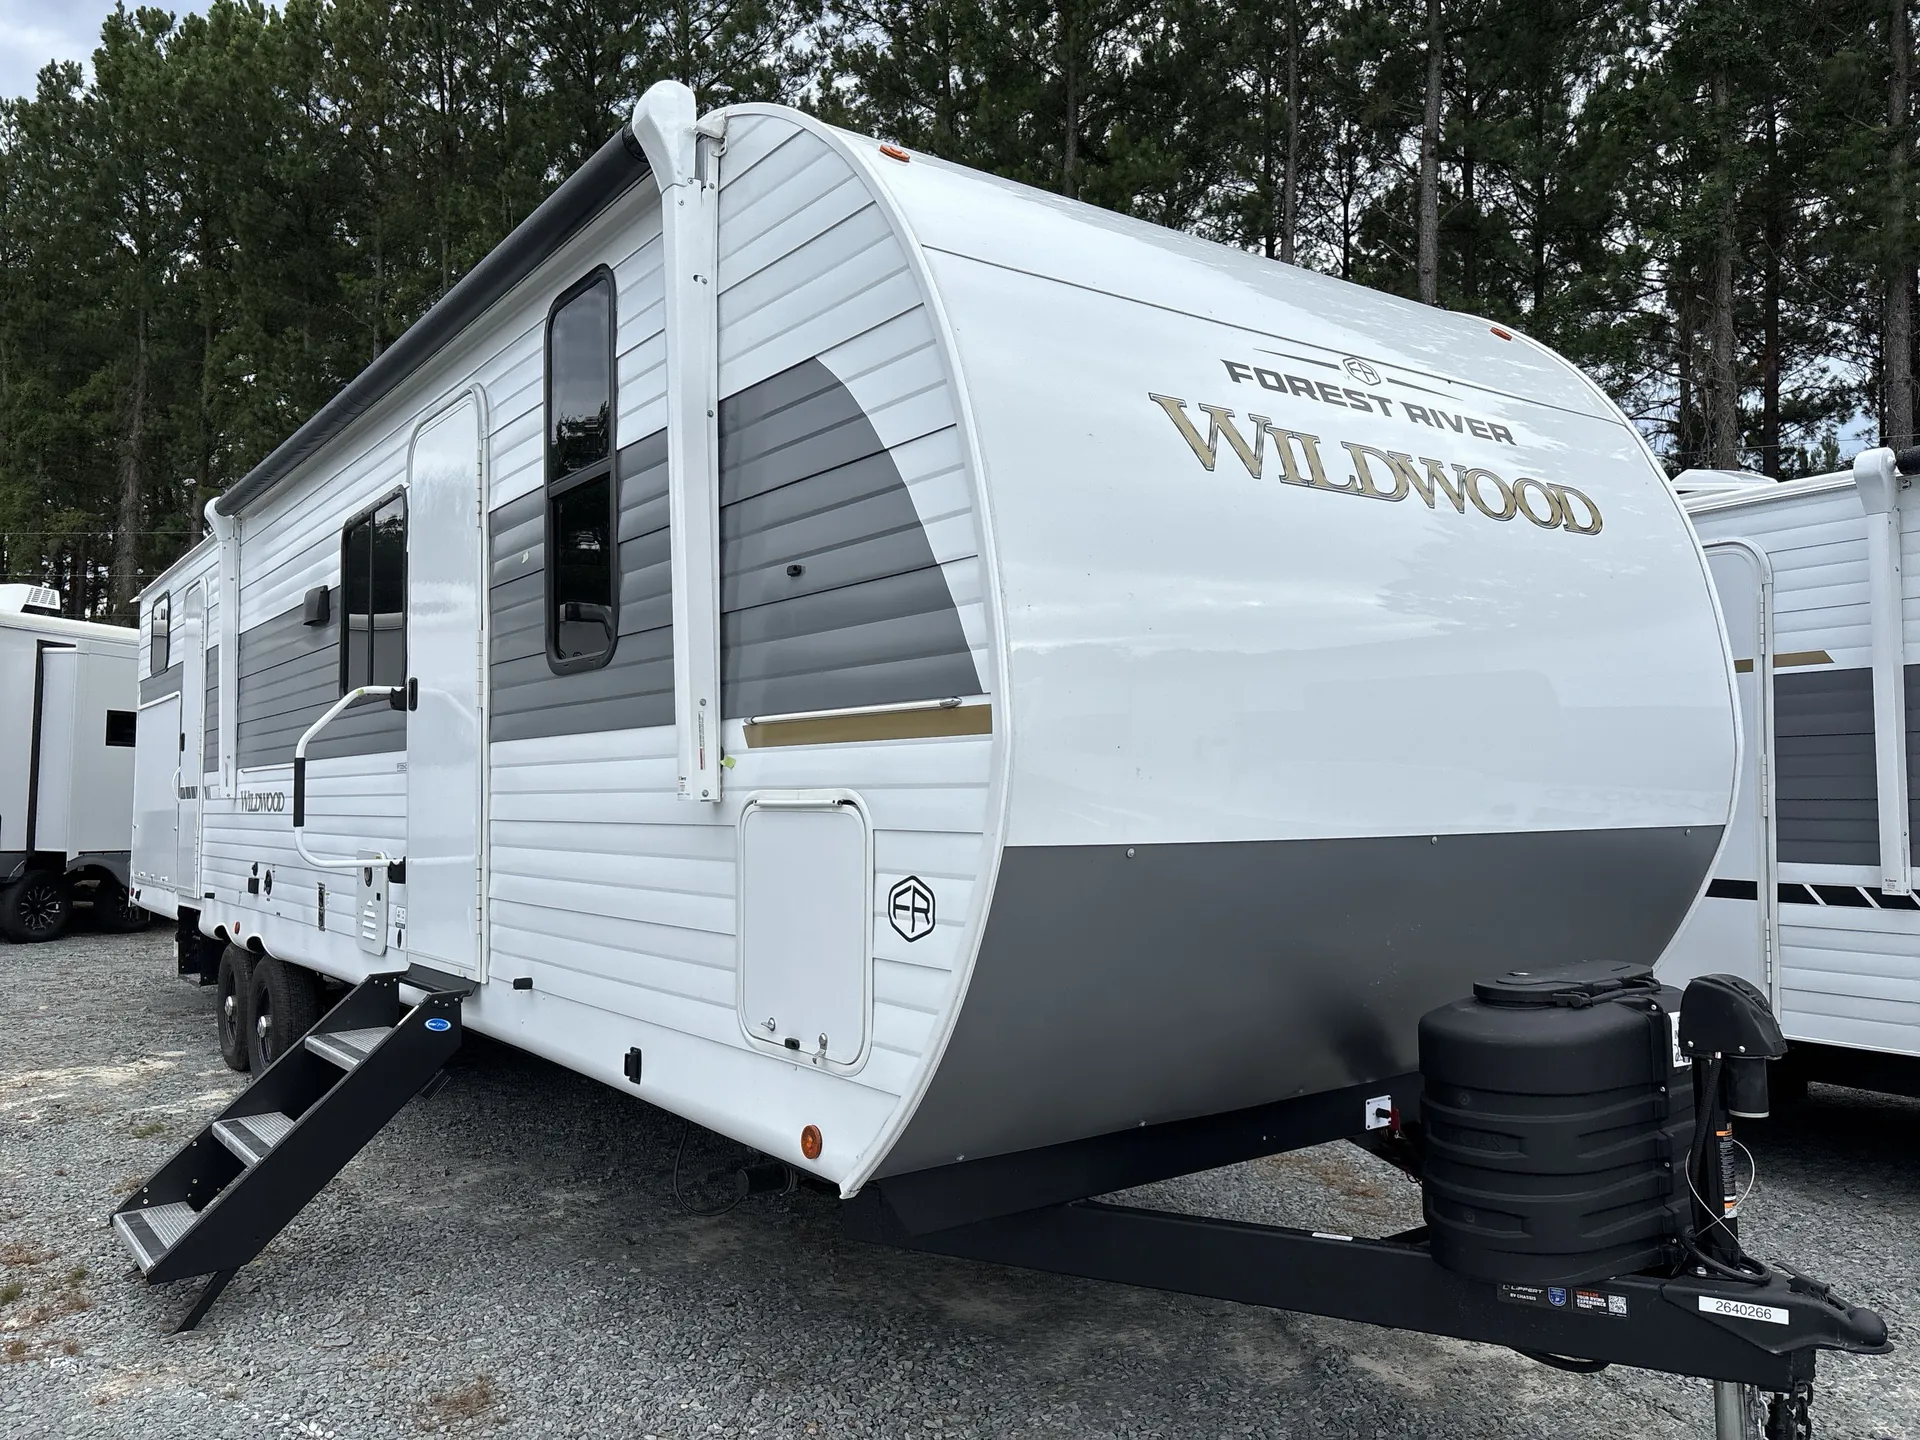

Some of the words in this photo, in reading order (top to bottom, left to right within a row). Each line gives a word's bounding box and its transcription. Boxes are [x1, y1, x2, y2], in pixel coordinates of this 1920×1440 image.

[1220, 358, 1392, 418] FOREST
[1400, 401, 1517, 446] RIVER
[1147, 391, 1604, 536] WILDWOOD
[240, 790, 285, 812] WILDWOOD
[1510, 1285, 1544, 1294] LIPPERT
[1577, 1299, 1607, 1307] EXPERIENCE
[1715, 1300, 1772, 1320] 2640266
